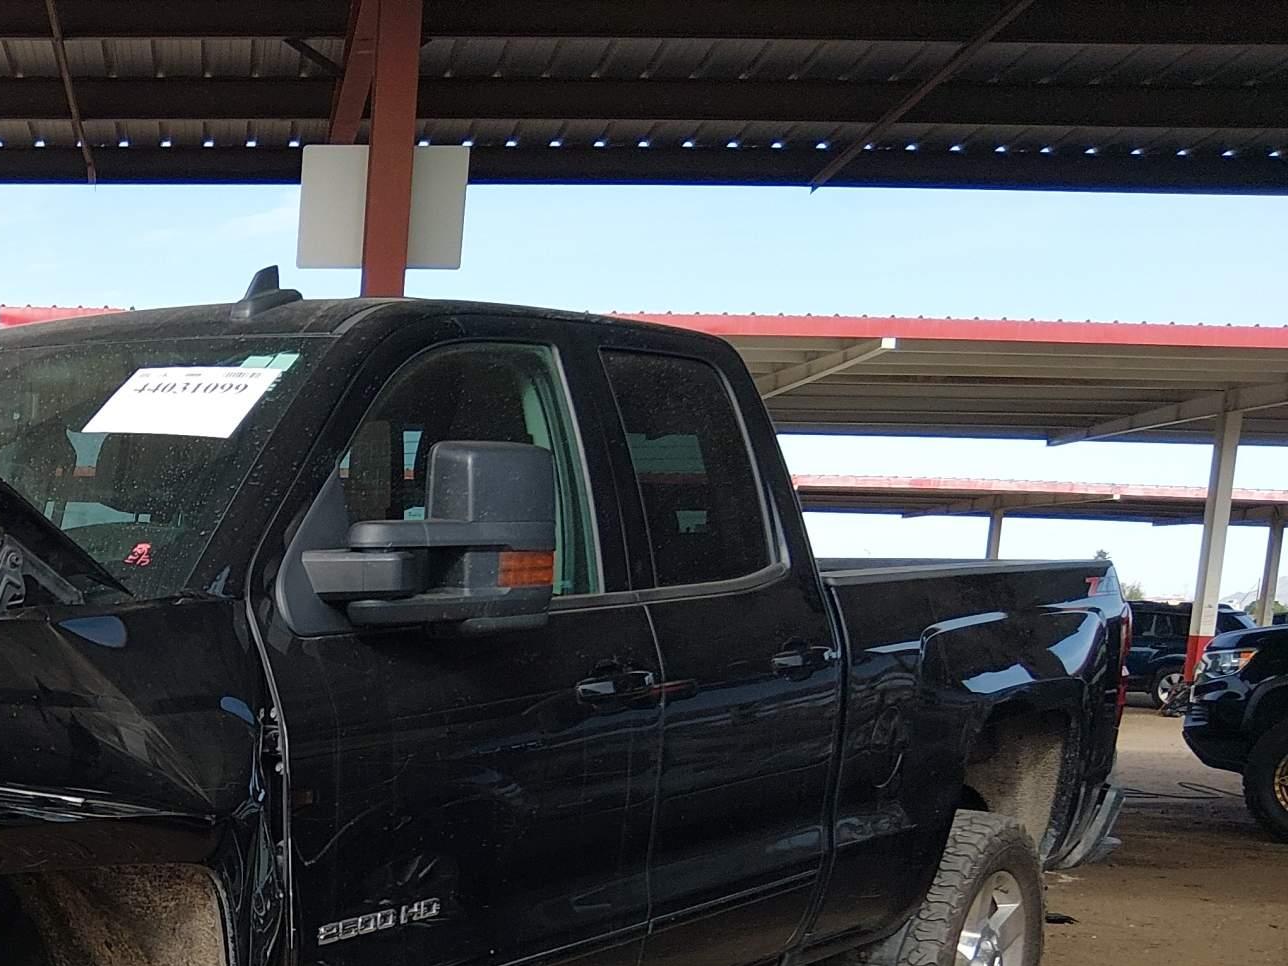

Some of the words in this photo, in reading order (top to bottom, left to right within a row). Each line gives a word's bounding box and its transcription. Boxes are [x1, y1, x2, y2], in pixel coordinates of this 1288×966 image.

[132, 381, 249, 395] 44031099
[317, 909, 397, 946] 2500
[399, 897, 441, 925] HD
